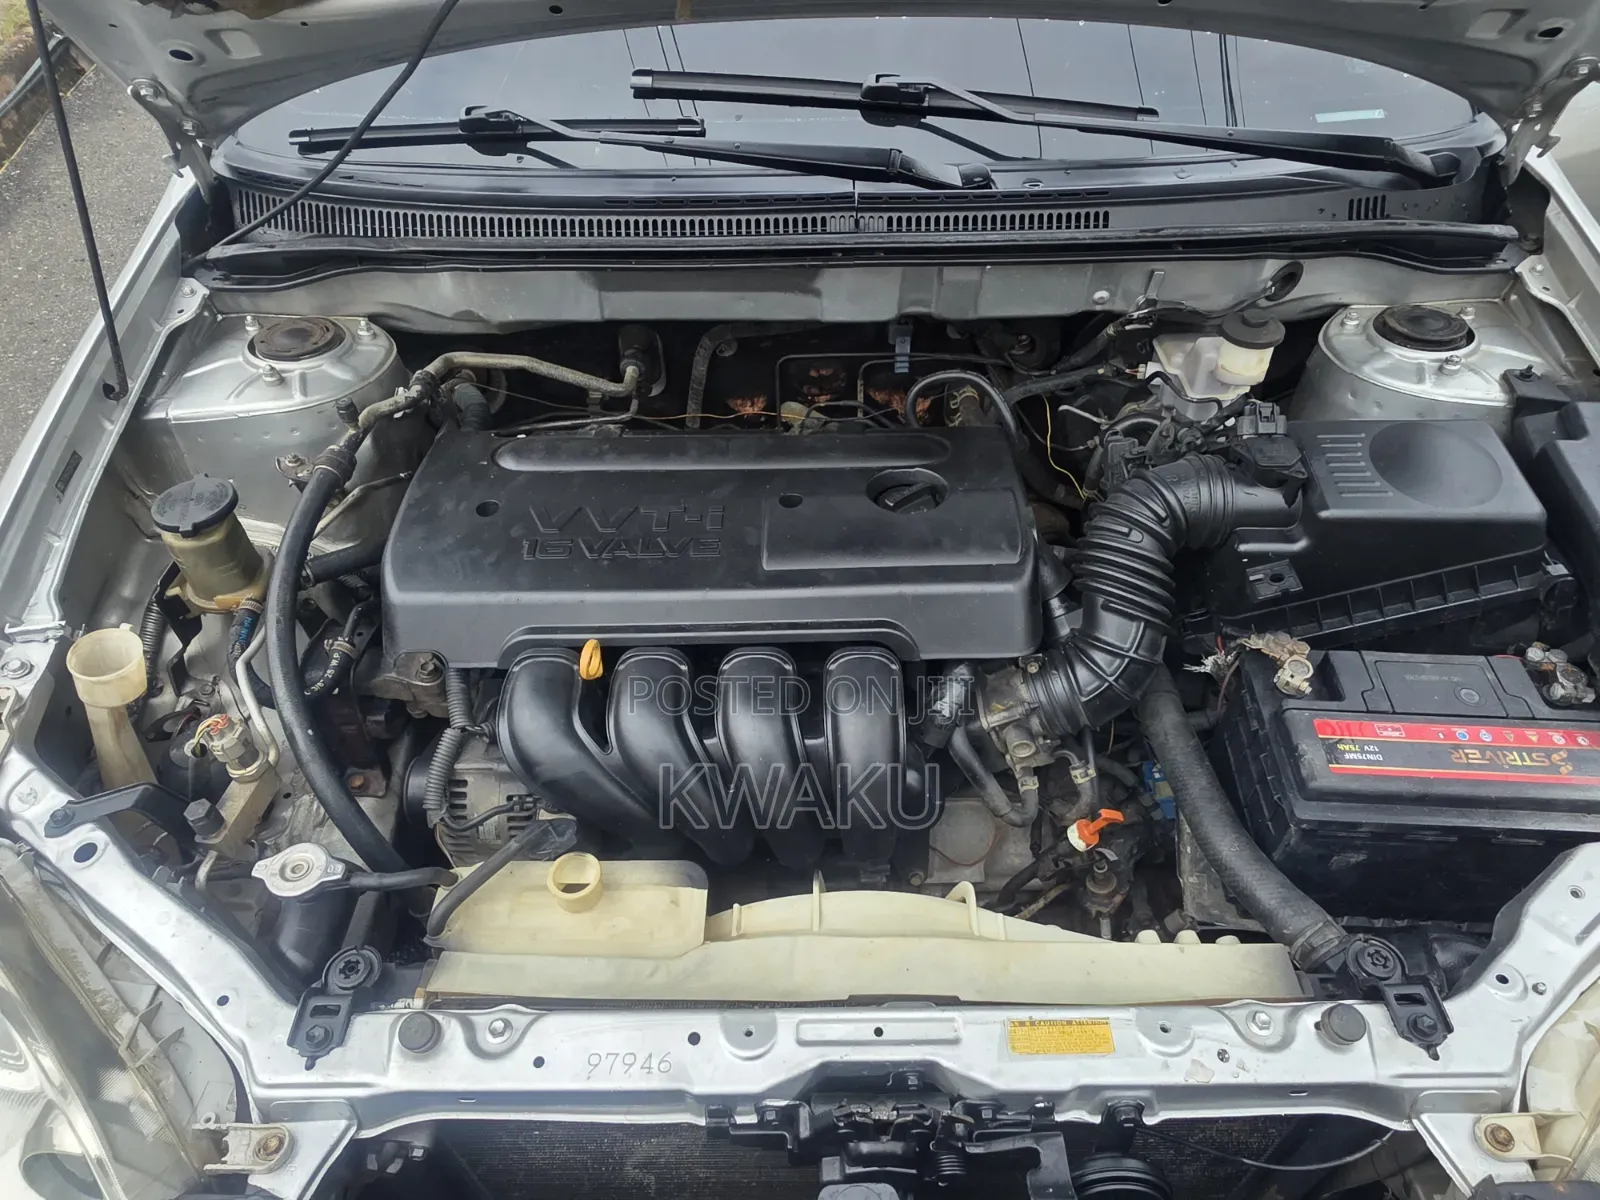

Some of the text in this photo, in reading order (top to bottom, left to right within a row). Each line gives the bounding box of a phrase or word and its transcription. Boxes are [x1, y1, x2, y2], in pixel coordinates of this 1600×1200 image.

[529, 505, 725, 533] VVT-i
[1343, 752, 1384, 761] DIN75MF
[587, 1051, 672, 1075] 97946
